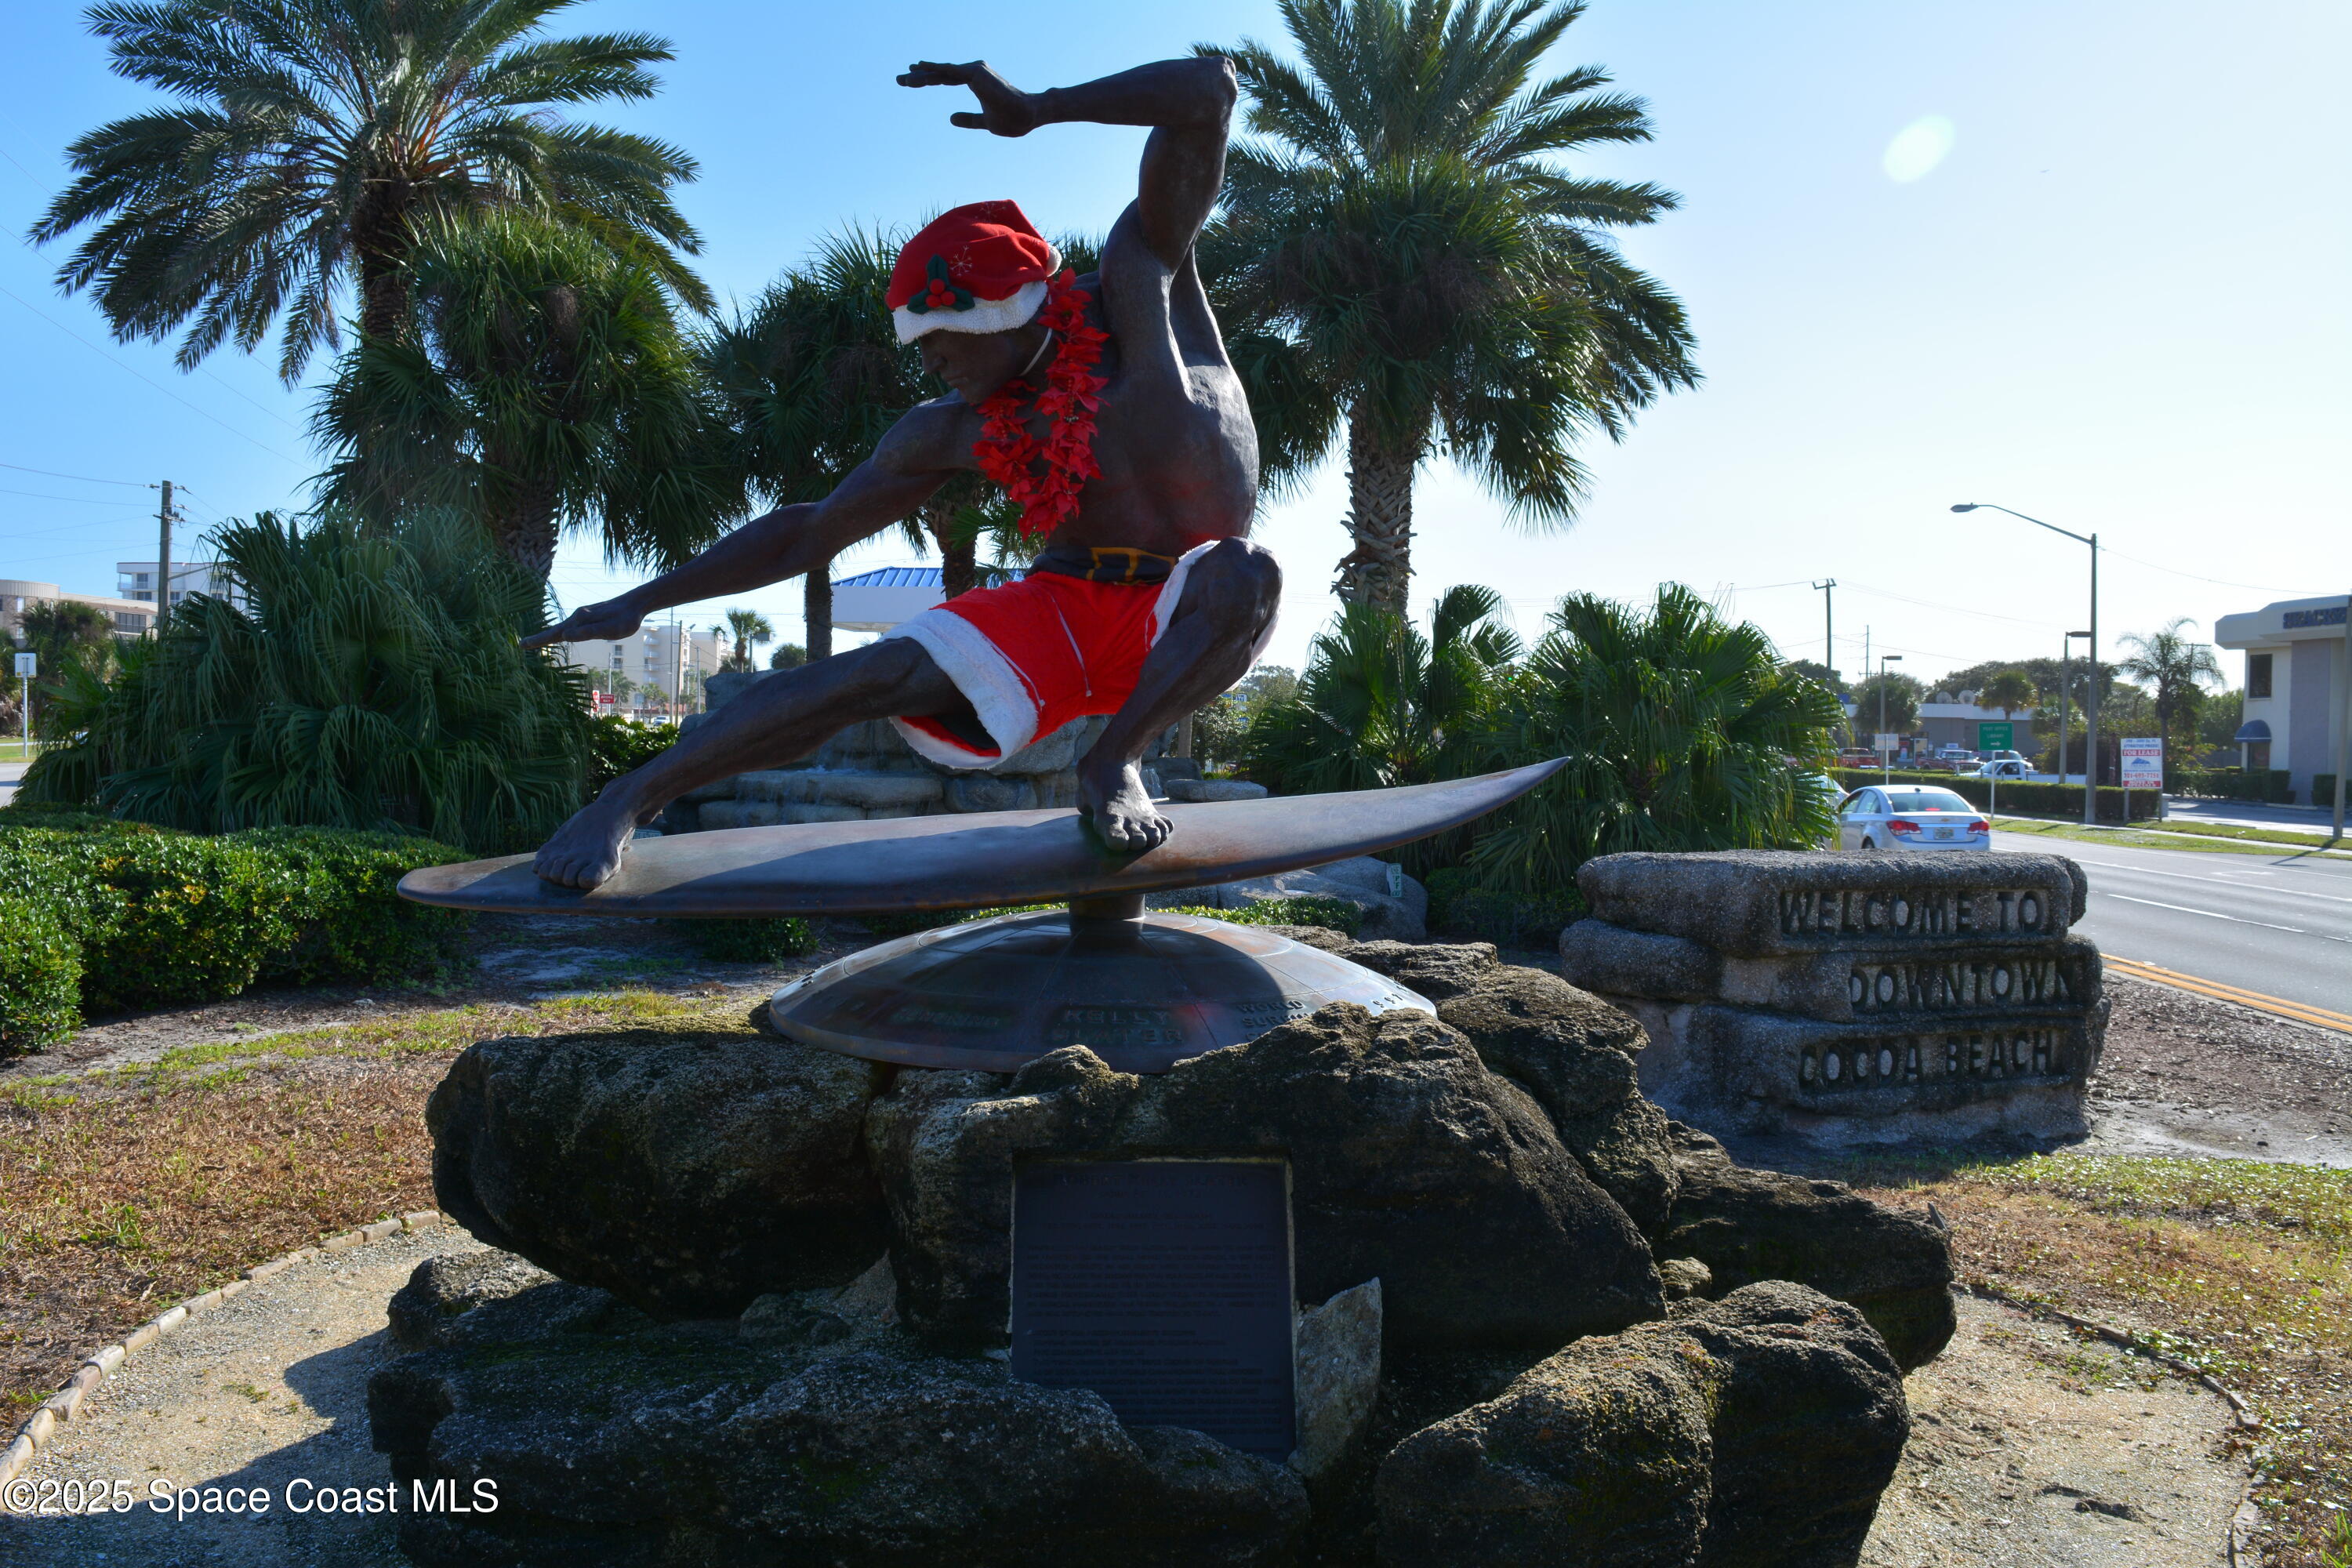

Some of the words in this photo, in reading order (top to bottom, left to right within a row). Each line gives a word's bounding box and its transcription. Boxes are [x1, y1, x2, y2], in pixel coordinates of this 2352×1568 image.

[1780, 891, 1973, 935] WELCOME
[1998, 891, 2044, 933] TO
[1236, 1000, 1305, 1013] WORLD
[1849, 961, 2076, 1009] DOWNTOWN
[1062, 1009, 1172, 1026] KELLY
[1799, 1040, 1924, 1087] COCOA
[1945, 1029, 2054, 1077] BEACH
